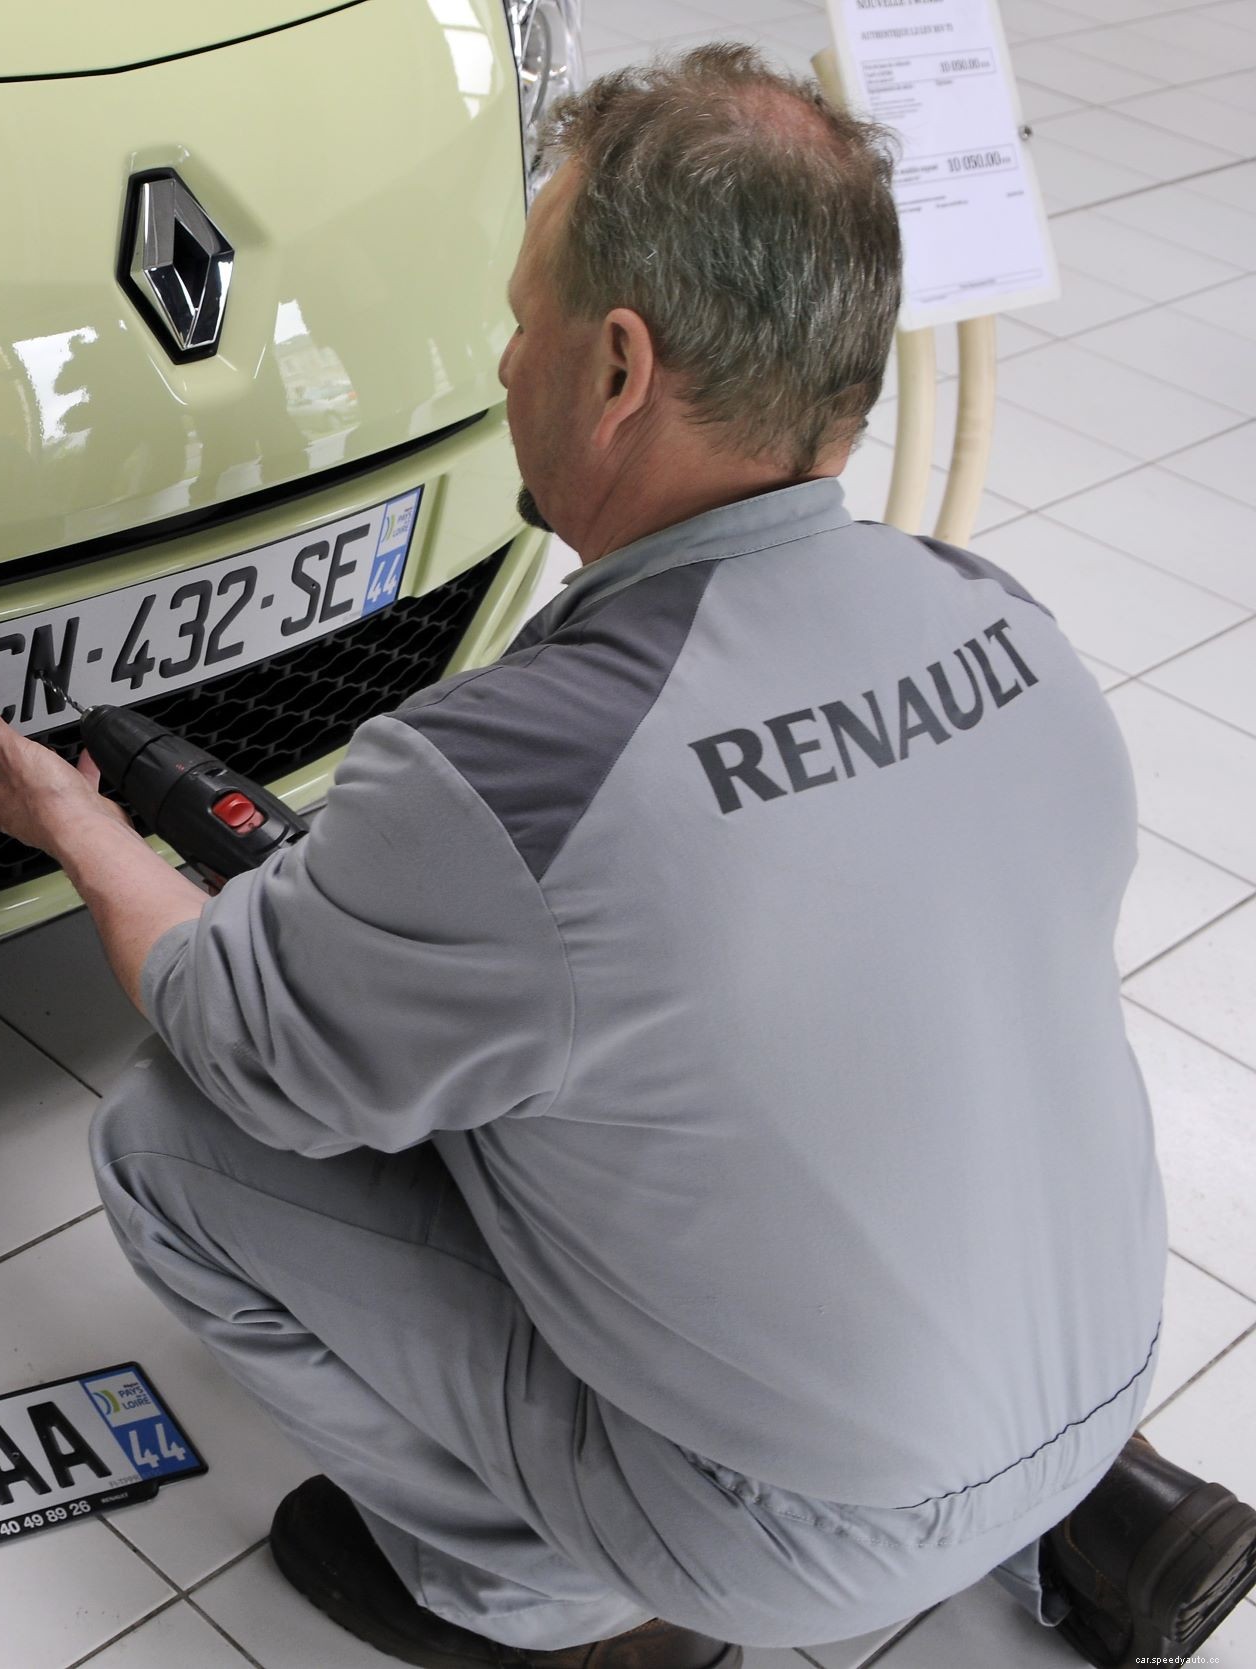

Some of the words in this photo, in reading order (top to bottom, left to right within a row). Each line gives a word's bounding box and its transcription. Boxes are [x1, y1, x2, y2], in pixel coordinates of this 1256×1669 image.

[367, 553, 400, 602] 44
[687, 617, 1039, 815] RENAULT
[118, 1386, 144, 1398] PAYS
[122, 1396, 151, 1410] LOIRE
[128, 1423, 186, 1468] 44
[0, 1519, 21, 1536] 40
[23, 1512, 44, 1530] 49
[46, 1505, 67, 1522] 89
[71, 1500, 91, 1517] 26
